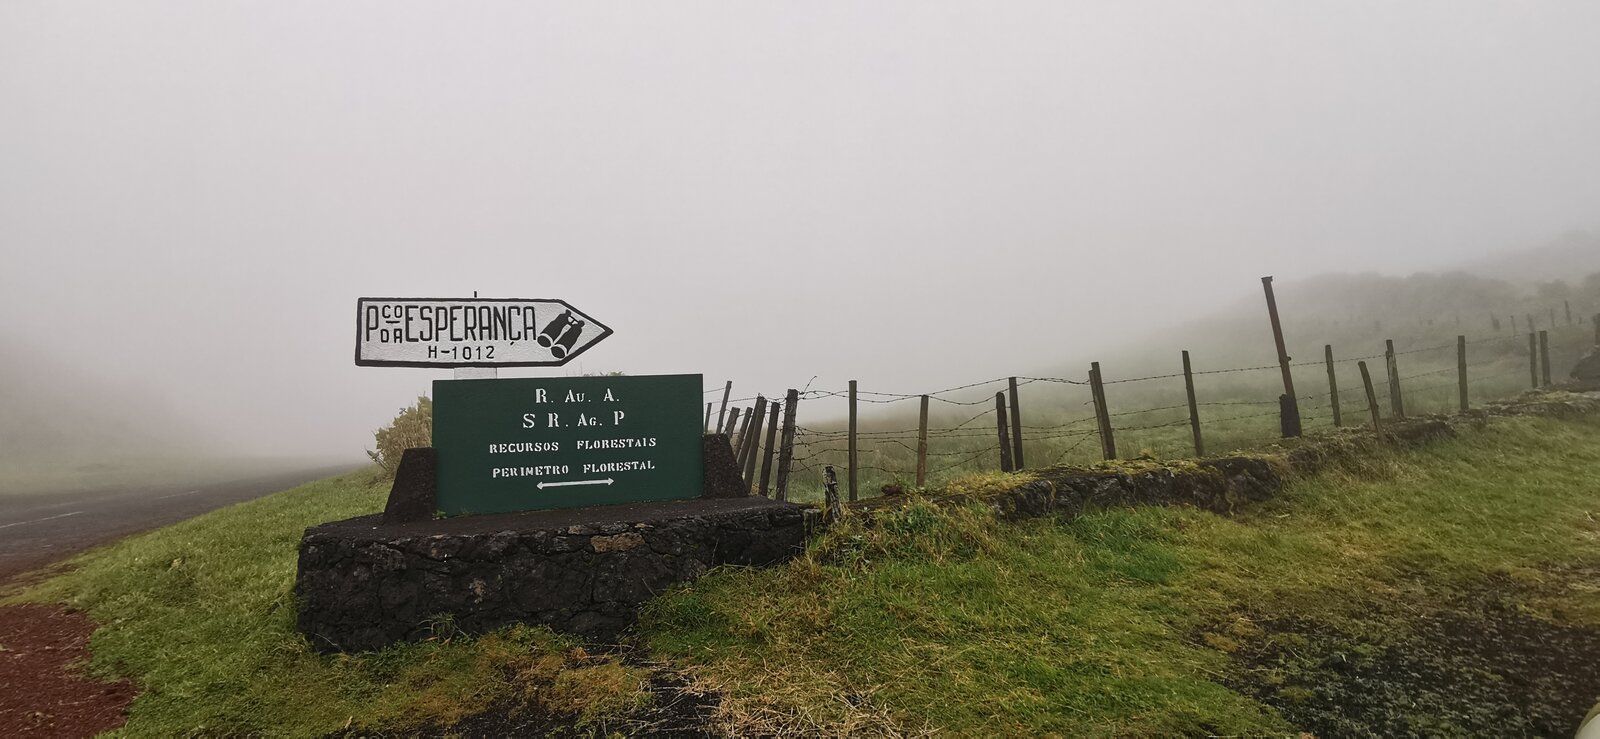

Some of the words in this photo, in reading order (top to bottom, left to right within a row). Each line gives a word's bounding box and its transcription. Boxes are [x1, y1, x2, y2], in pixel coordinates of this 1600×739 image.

[404, 304, 537, 346] ESPERANÇA
[427, 346, 495, 361] H-1012
[522, 413, 535, 429] S
[613, 410, 625, 426] P
[489, 441, 560, 454] RECURSOS
[576, 437, 657, 450] FLORESTAIS
[492, 464, 569, 478] PERIMETRO
[582, 460, 656, 474] FLORESTAL
